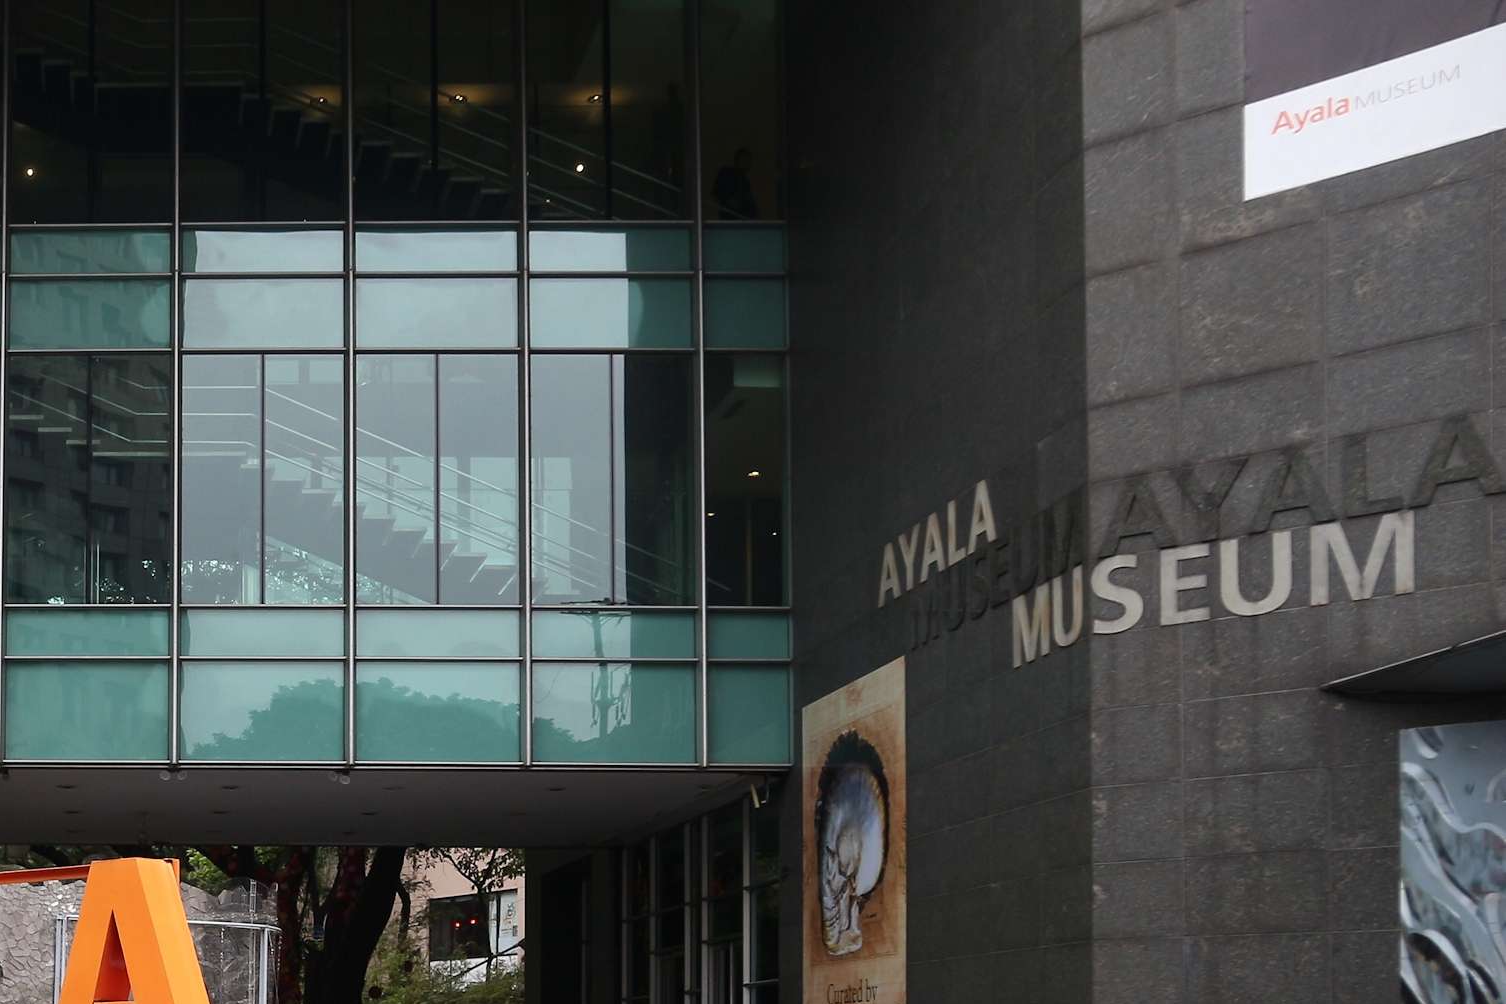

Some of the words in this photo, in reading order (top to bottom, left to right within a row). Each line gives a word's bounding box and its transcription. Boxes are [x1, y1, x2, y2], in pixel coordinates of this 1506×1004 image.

[1271, 97, 1351, 135] Ayala
[1355, 64, 1462, 111] MUSEUM
[878, 479, 997, 608] AYALA
[1012, 510, 1415, 669] MUSEUM
